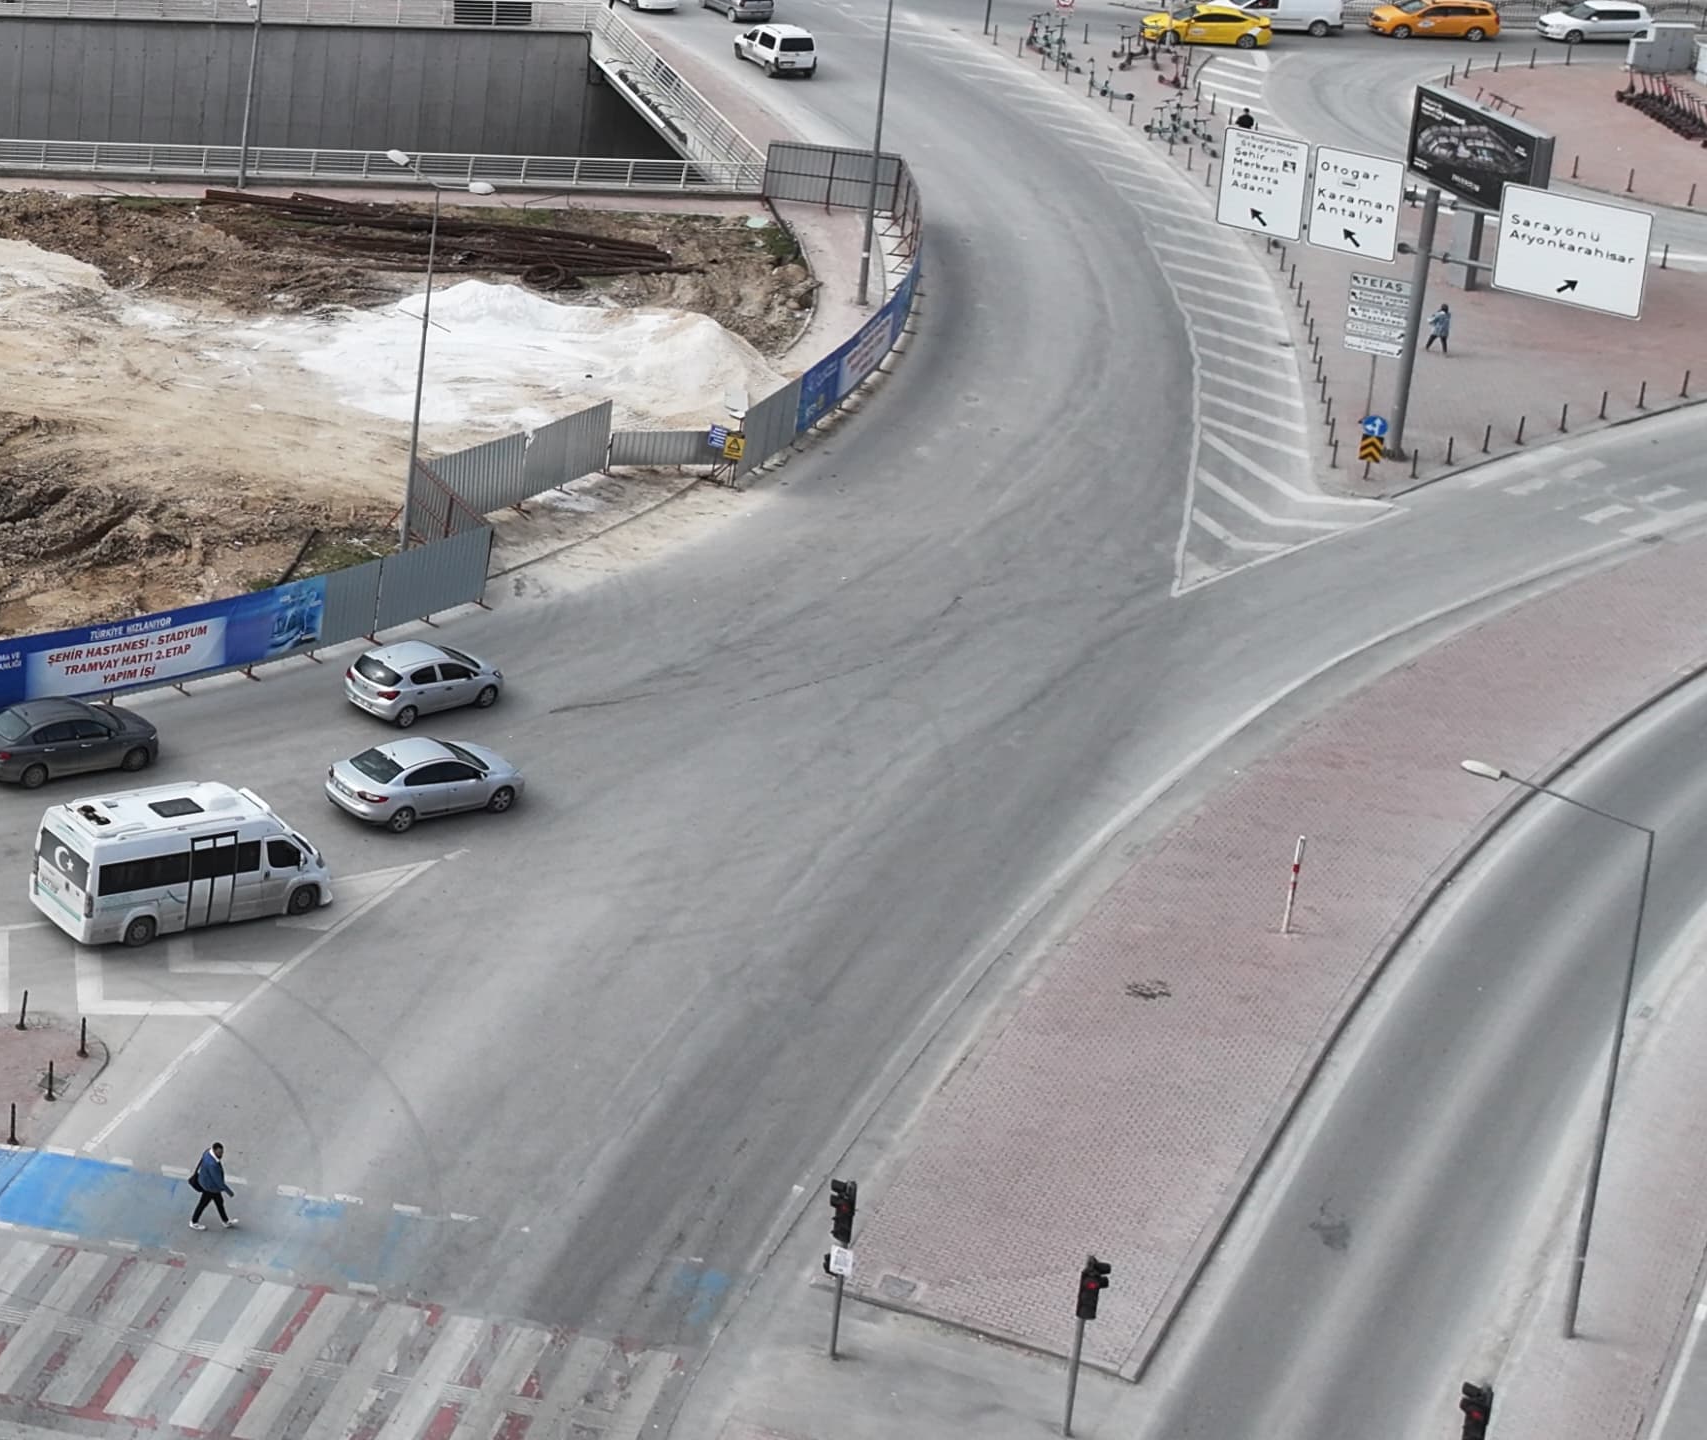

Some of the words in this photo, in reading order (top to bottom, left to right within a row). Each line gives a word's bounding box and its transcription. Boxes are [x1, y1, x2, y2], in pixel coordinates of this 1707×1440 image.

[1233, 157, 1279, 174] Merkezi
[1320, 160, 1380, 182] Otogar
[1231, 180, 1273, 196] Adana
[1317, 187, 1395, 212] Karaman
[1316, 202, 1384, 225] Antalya
[1511, 213, 1601, 243] Sarayönü
[1509, 229, 1636, 265] Afyonkarahisar
[90, 626, 124, 641] TÜRKİYE
[47, 649, 84, 667] ŞEHİR
[86, 639, 149, 659] HASTANESİ
[157, 625, 208, 645] STADYUM
[64, 658, 119, 677] TRAMVAY
[120, 653, 153, 669] HATTI
[155, 643, 191, 662] 2.ETAP
[102, 669, 136, 685] YAPIM
[139, 665, 155, 678] İŞİ
